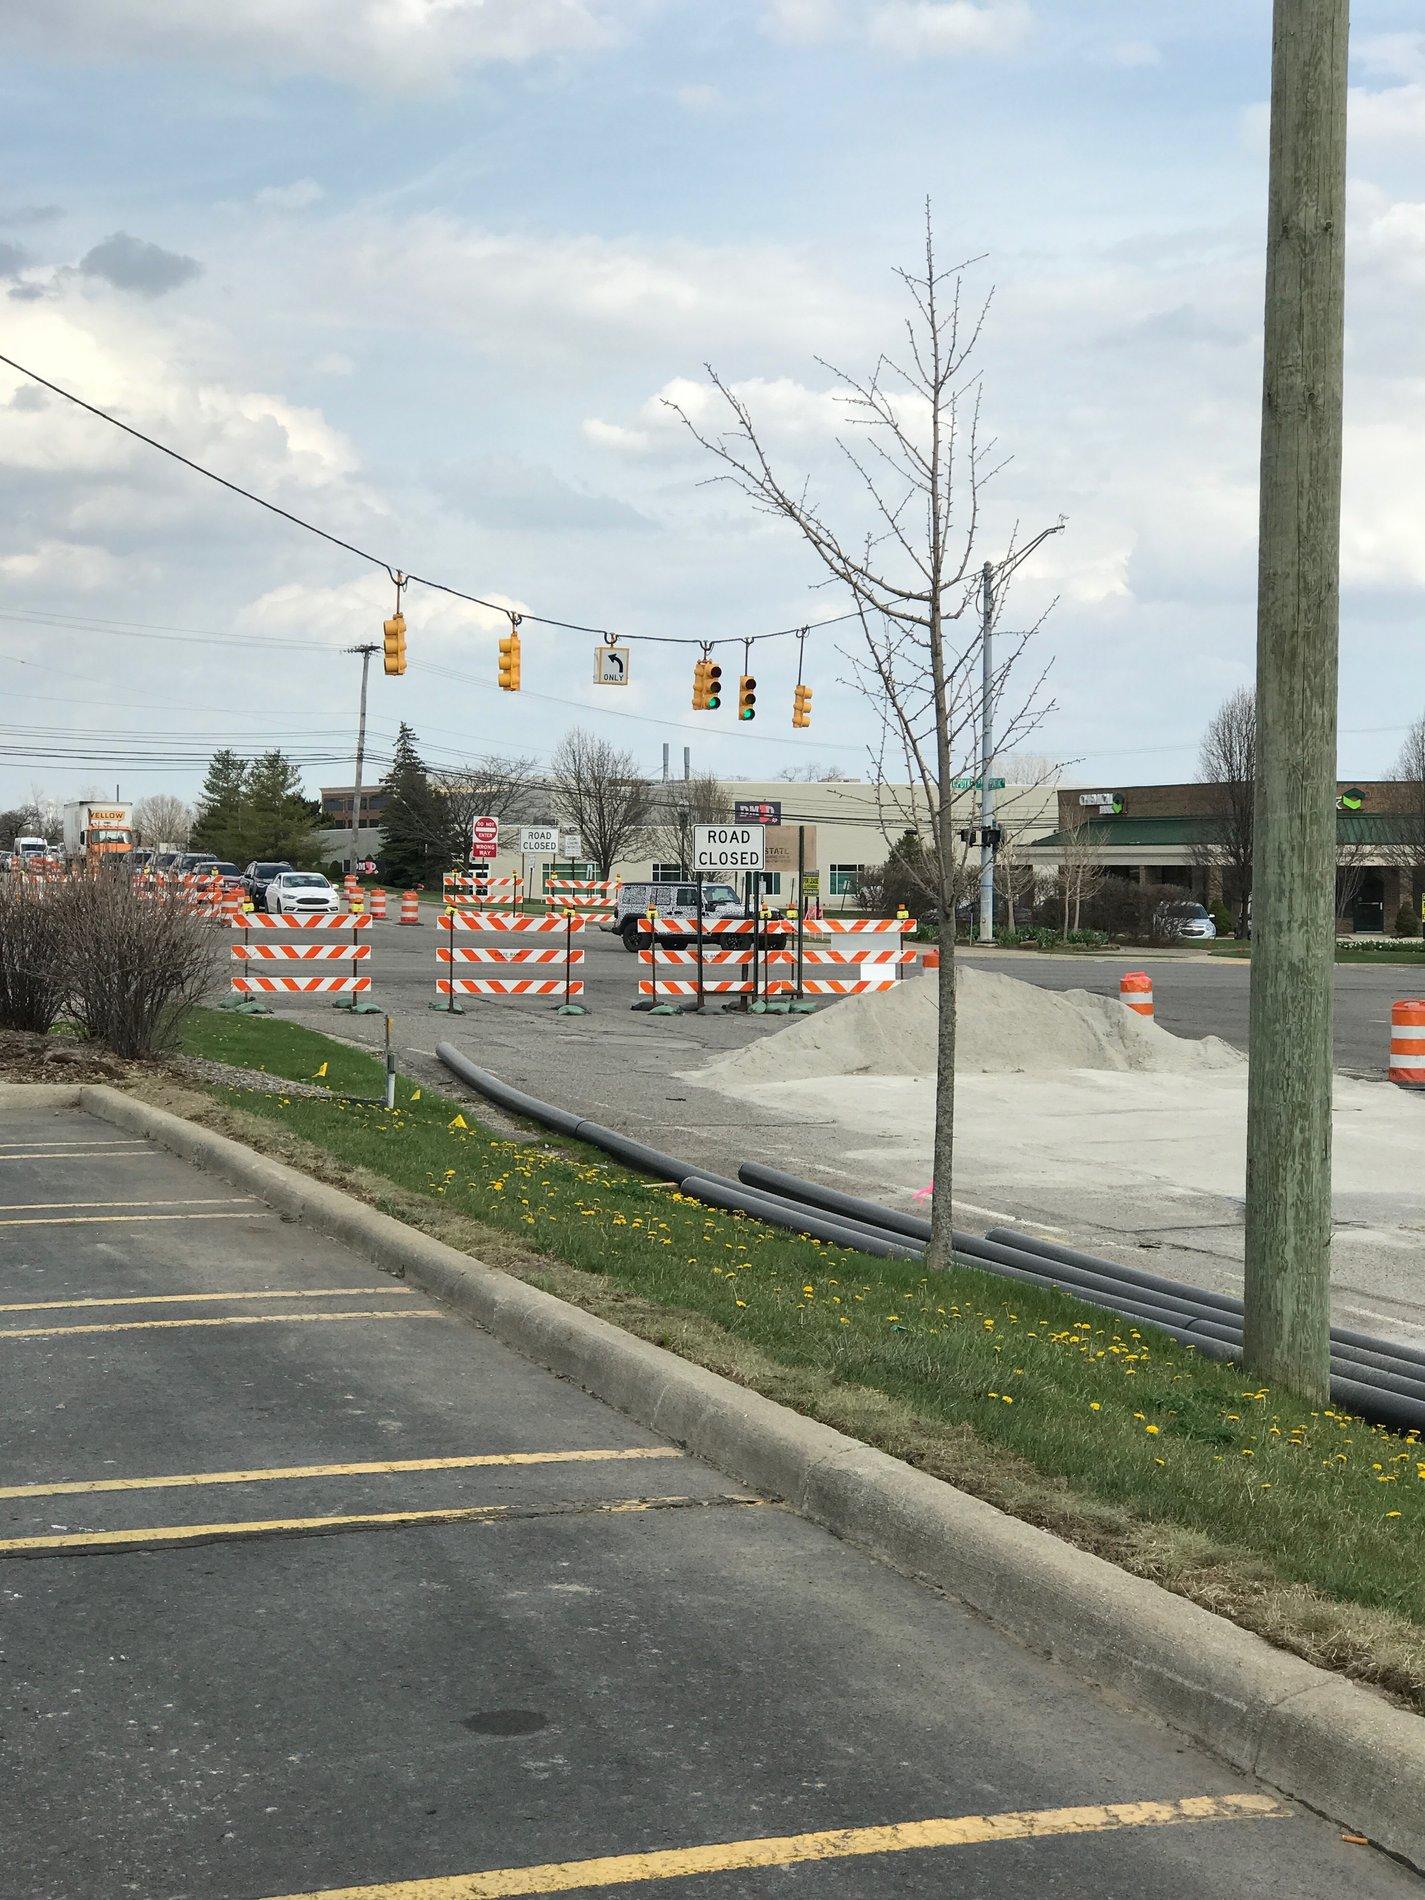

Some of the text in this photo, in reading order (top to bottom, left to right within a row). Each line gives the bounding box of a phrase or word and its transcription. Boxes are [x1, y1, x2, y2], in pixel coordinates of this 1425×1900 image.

[528, 832, 552, 840] ROAD
[708, 830, 750, 844] ROAD
[523, 842, 557, 850] CLOSED
[699, 852, 759, 865] CLOSED
